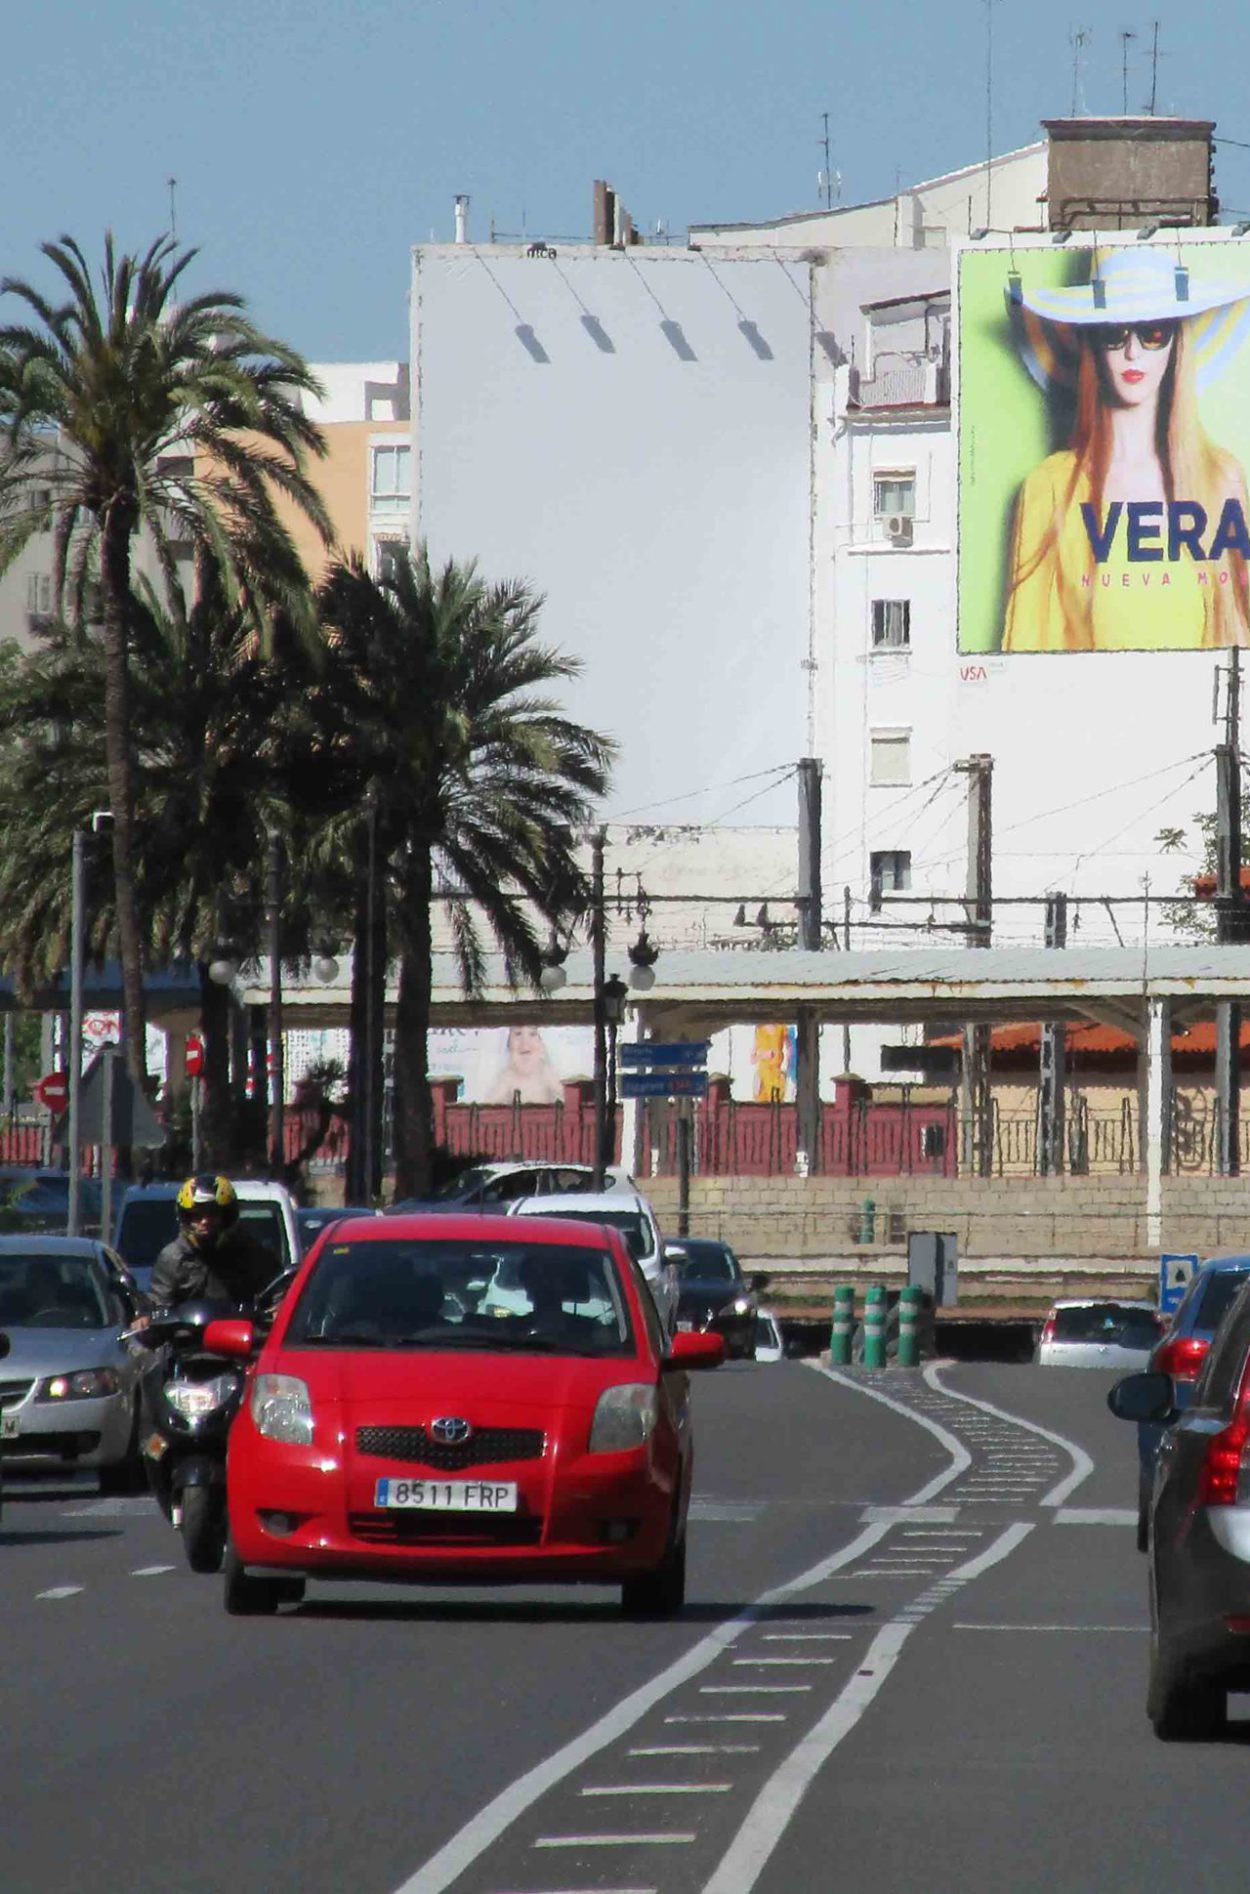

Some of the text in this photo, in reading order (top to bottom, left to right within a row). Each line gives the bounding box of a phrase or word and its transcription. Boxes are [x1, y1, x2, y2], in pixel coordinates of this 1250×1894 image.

[1081, 572, 1171, 587] NUEVA
[396, 1483, 508, 1508] 8511 FRP
